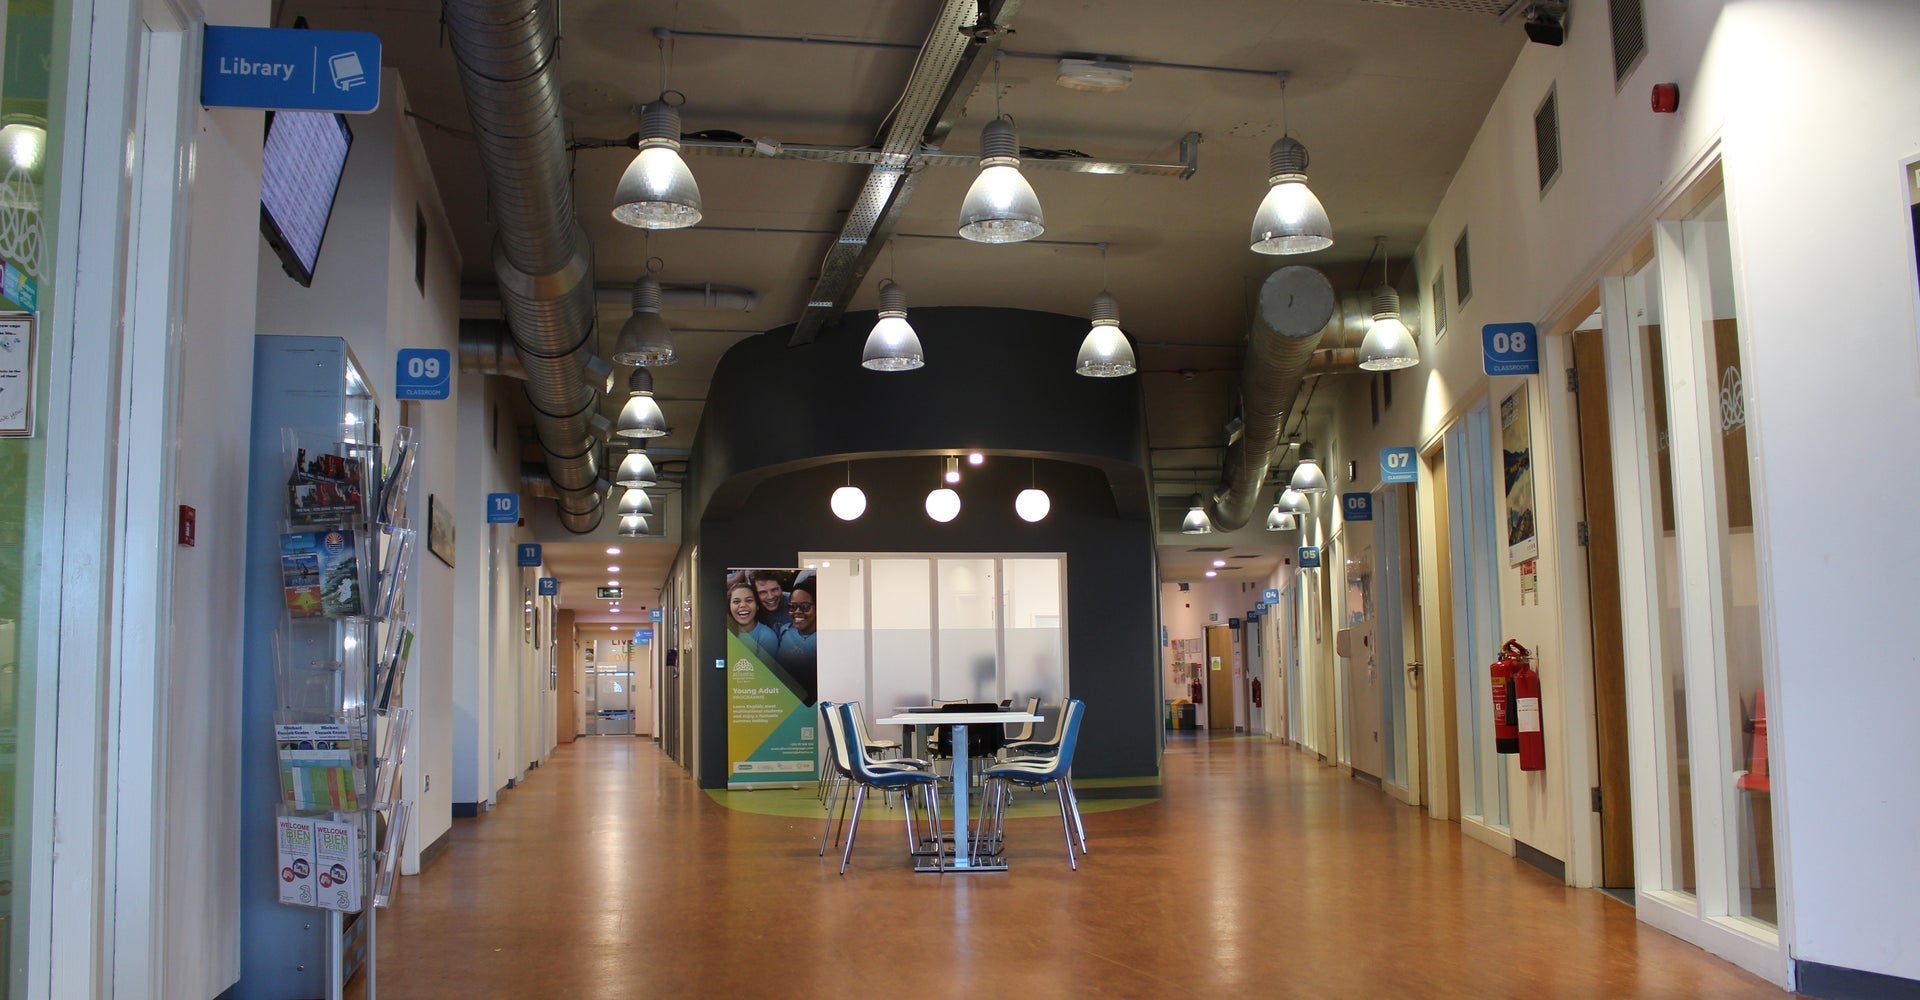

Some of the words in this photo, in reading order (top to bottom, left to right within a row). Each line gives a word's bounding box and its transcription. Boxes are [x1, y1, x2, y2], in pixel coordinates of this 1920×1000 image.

[220, 56, 295, 81] Library
[1493, 331, 1526, 353] 08
[408, 357, 440, 378] 09
[1387, 452, 1409, 468] 07
[495, 498, 511, 511] 10
[1348, 497, 1366, 509] 06
[525, 547, 535, 557] 11
[1302, 550, 1316, 559] 05
[543, 580, 553, 588] 12
[1265, 591, 1276, 599] 04
[733, 687, 757, 695] Young
[280, 822, 310, 831] WELCOME
[317, 826, 348, 835] WELCOME
[286, 829, 310, 840] BIEN
[323, 833, 348, 845] BIEN
